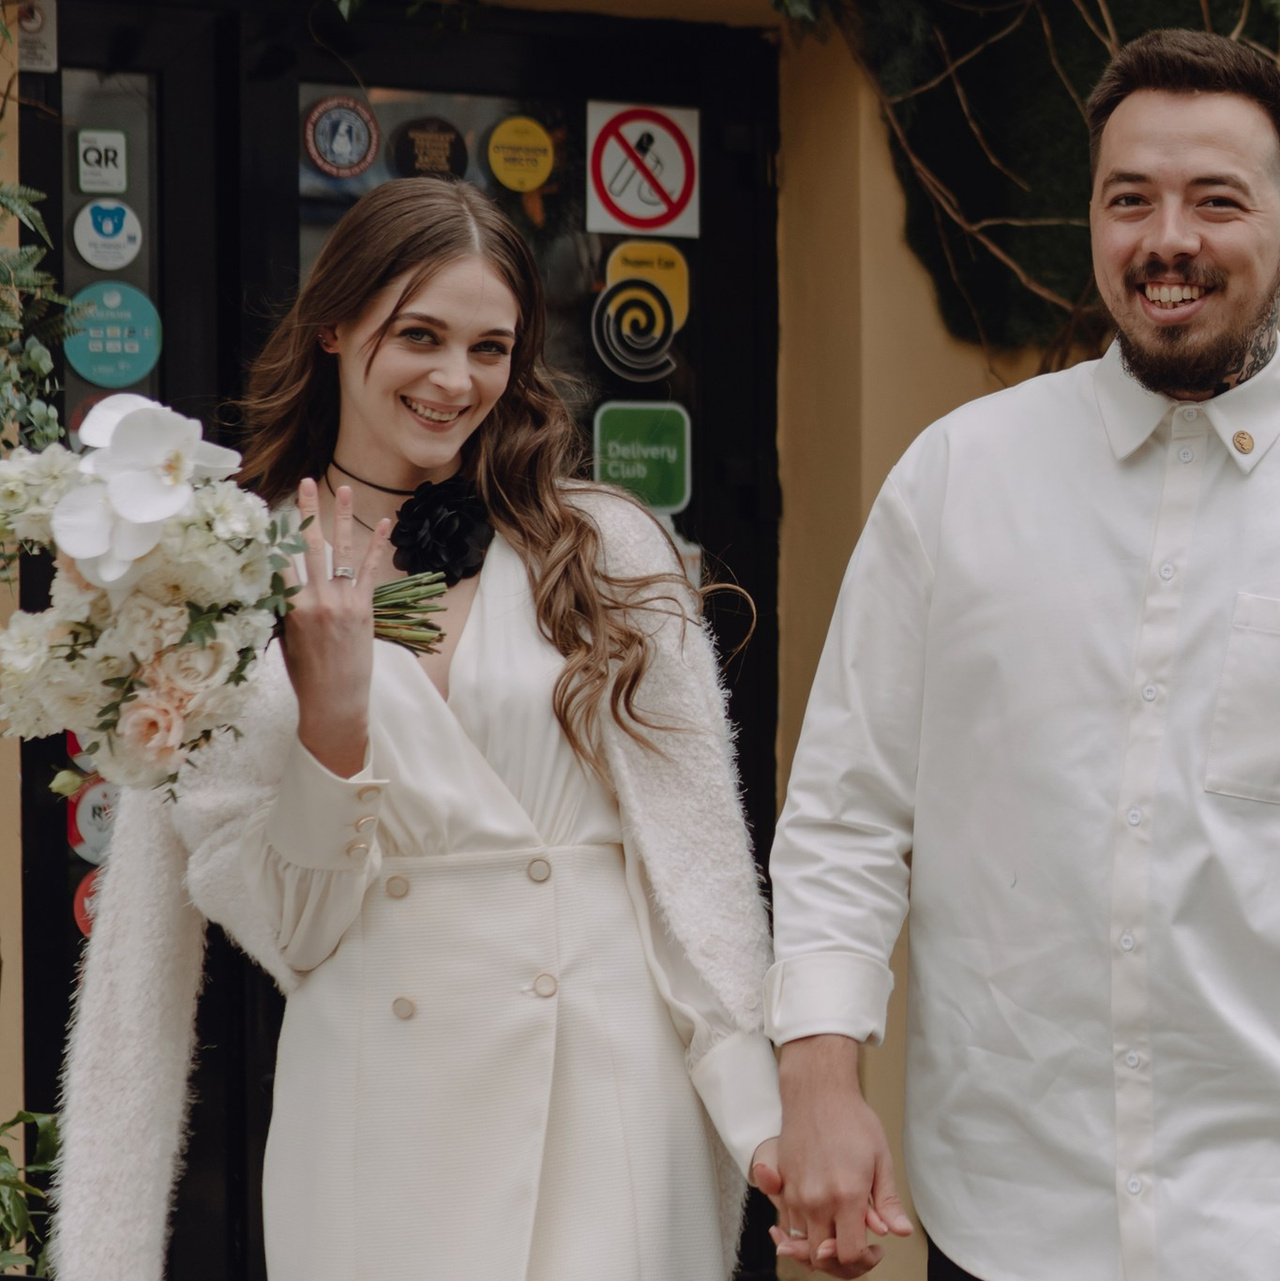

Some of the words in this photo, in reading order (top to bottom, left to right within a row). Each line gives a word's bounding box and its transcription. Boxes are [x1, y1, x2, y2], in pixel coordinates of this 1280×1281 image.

[82, 146, 119, 169] QR
[608, 441, 677, 464] Delivery
[608, 461, 648, 479] Club
